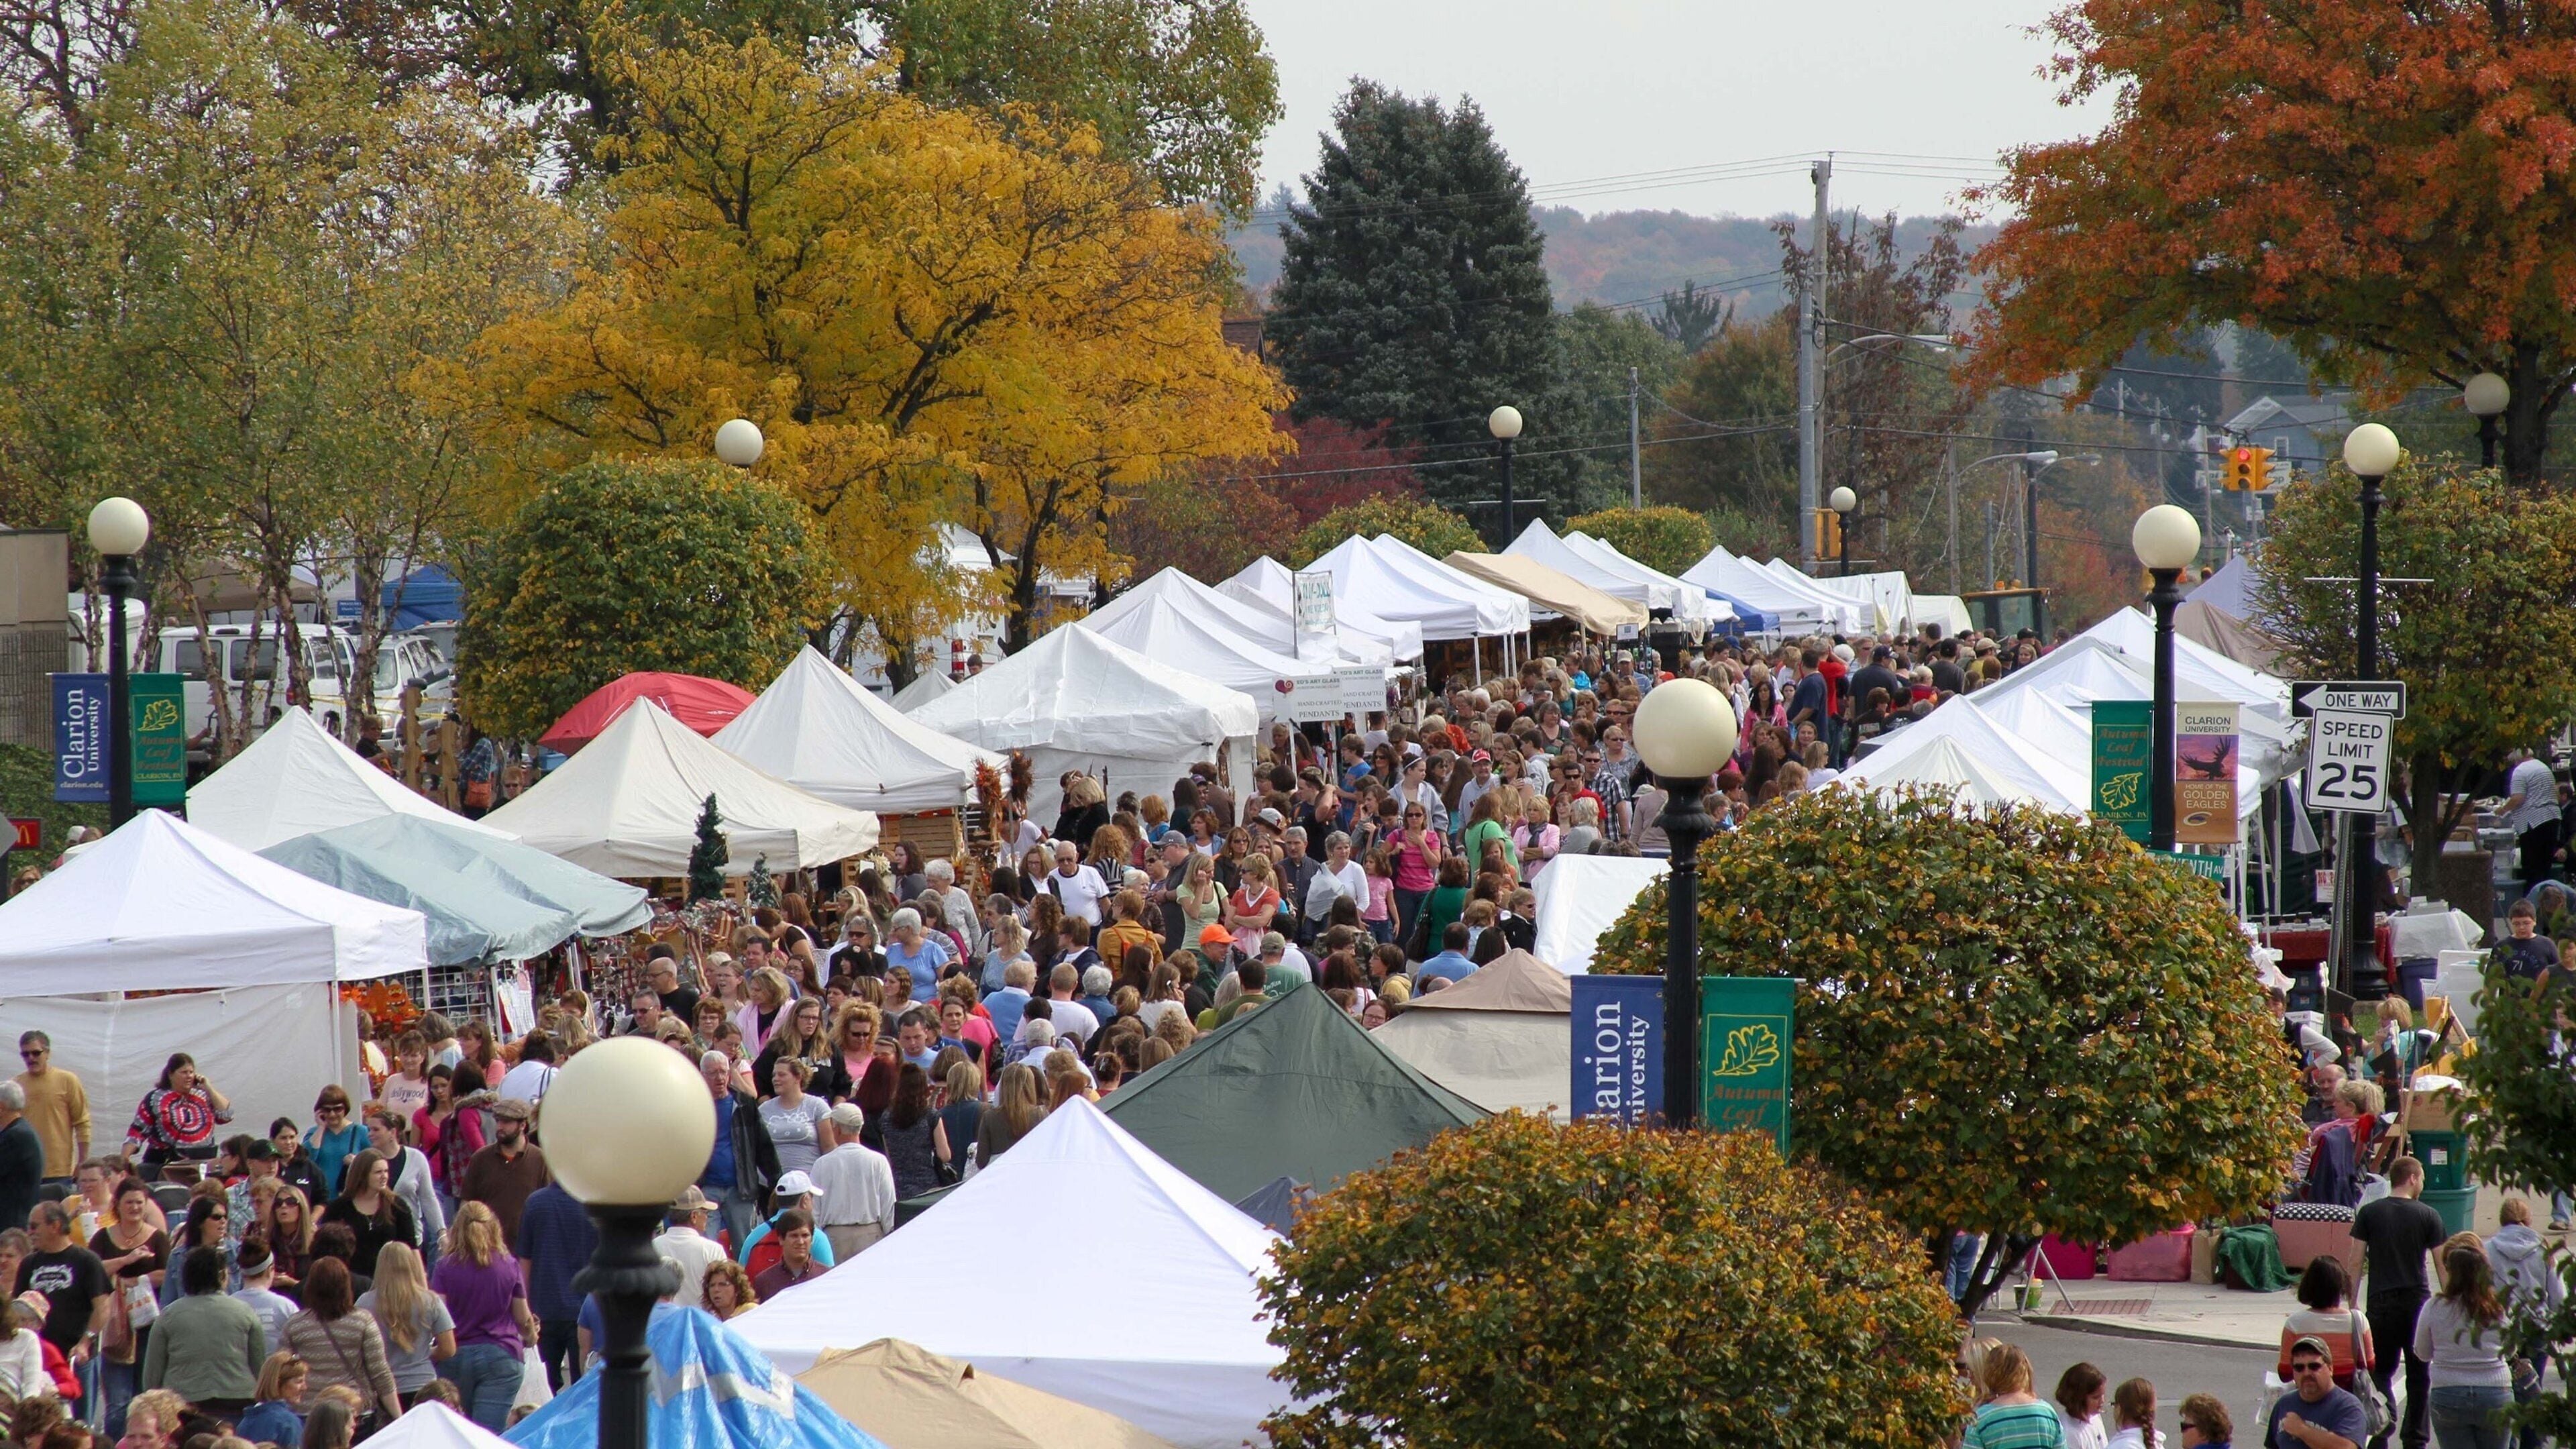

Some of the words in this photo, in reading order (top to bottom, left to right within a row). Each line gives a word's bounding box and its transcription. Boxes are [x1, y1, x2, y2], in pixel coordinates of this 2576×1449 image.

[2325, 694, 2357, 707] ONE
[2361, 694, 2392, 708] WAY
[1299, 710, 1340, 718] PENDANTS
[2185, 716, 2231, 725] CLARION
[62, 689, 85, 778] Clarion
[87, 696, 101, 772] University
[2098, 727, 2147, 740] Autumn
[2322, 721, 2383, 739] SPEED
[2106, 740, 2136, 755] Leaf
[2327, 741, 2373, 759] LIMIT
[2097, 754, 2146, 767] Festival
[2318, 762, 2377, 800] 25
[2183, 790, 2230, 800] GOLDEN
[2186, 800, 2227, 809] EAGLES
[1585, 1001, 1621, 1132] larion
[1626, 1015, 1650, 1132] niversity
[1708, 1084, 1783, 1100] Autumn
[1722, 1102, 1768, 1124] Leaf
